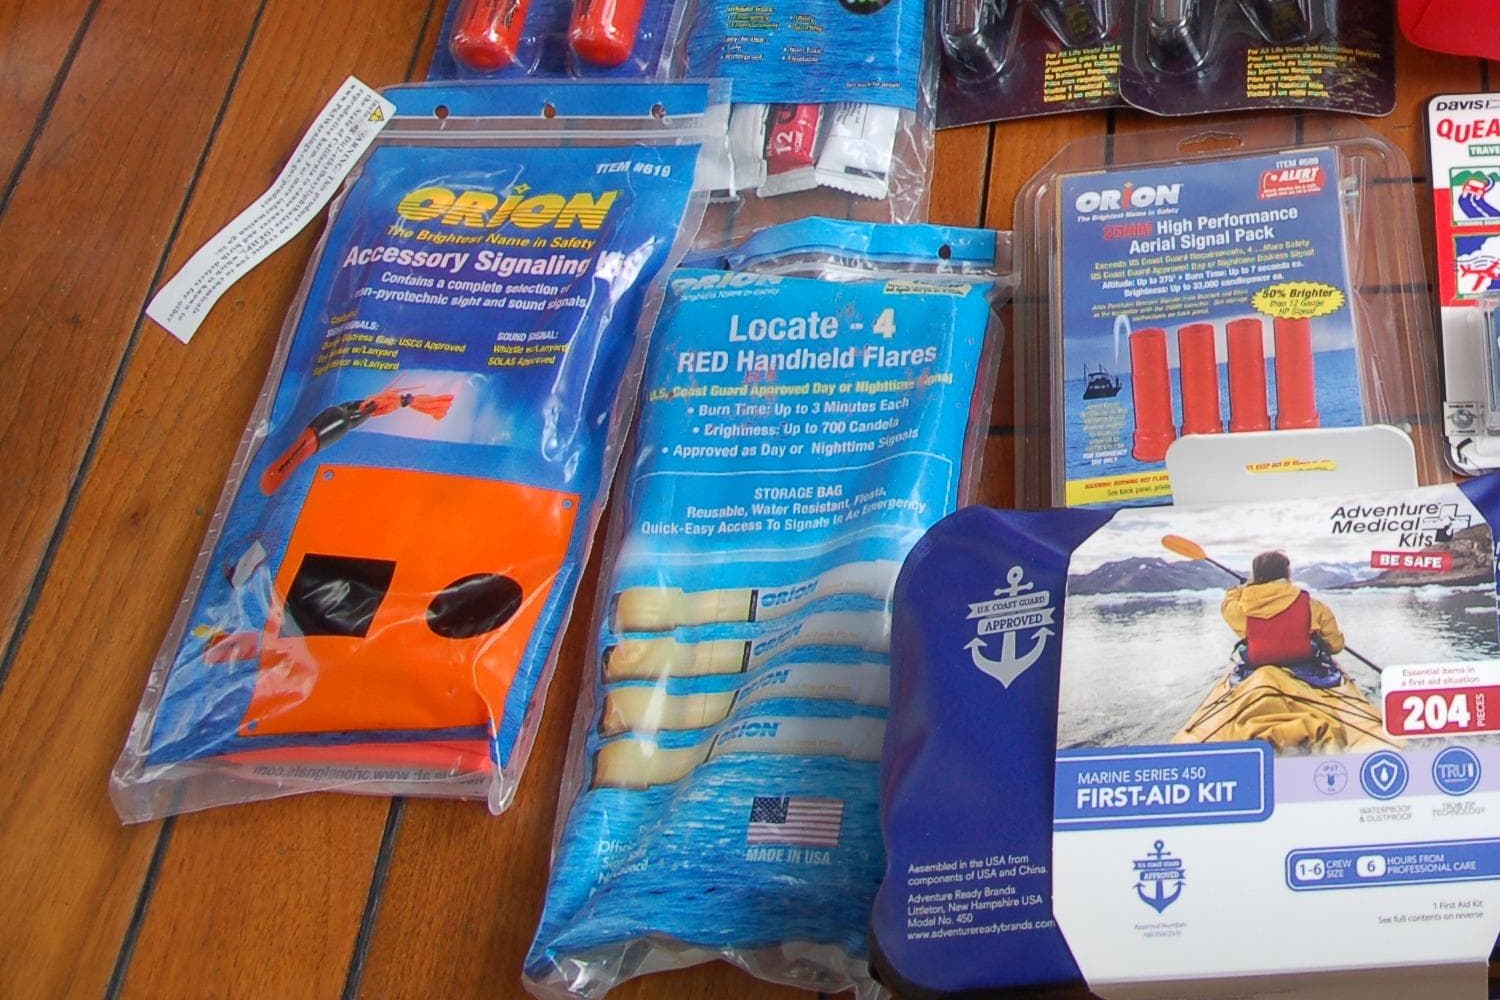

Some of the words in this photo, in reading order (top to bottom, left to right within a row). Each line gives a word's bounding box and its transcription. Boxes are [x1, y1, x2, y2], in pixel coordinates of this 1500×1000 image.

[776, 130, 793, 154] 12
[596, 161, 631, 175] ITEM
[396, 183, 619, 230] ORION
[1075, 181, 1182, 213] ORION
[1157, 219, 1192, 236] High
[1197, 207, 1299, 231] Performance
[417, 228, 484, 246] Brightest
[486, 232, 530, 248] Name
[534, 235, 547, 248] in
[550, 236, 597, 251] Safety
[1129, 236, 1176, 255] Aerial
[1180, 232, 1231, 252] Signal
[1235, 226, 1275, 242] Pack
[343, 246, 470, 273] Accessory
[475, 249, 592, 278] Signaling
[1262, 288, 1286, 299] 50%
[1289, 288, 1333, 299] Brighter
[729, 310, 839, 342] Locate
[872, 308, 896, 339] 4
[678, 351, 728, 374] RED
[736, 347, 855, 372] Handheld
[862, 345, 938, 368] Flares
[699, 403, 730, 417] Burn
[735, 402, 771, 417] Time:
[774, 402, 792, 418] Up
[794, 402, 808, 415] to
[811, 402, 821, 414] 3
[823, 400, 877, 414] Minutes
[880, 396, 909, 411] Each
[704, 422, 780, 439] Brightness:
[783, 421, 800, 437] Up
[804, 422, 818, 435] to
[822, 421, 846, 434] 700
[850, 417, 899, 433] Candela
[674, 441, 738, 459] Approved
[742, 444, 757, 457] as
[761, 441, 786, 459] Day
[790, 444, 804, 456] or
[811, 438, 875, 456] Nighttime
[878, 428, 919, 450] Signals
[754, 486, 814, 501] STORAGE
[817, 485, 843, 499] BAG
[1331, 503, 1439, 520] Adventure
[1332, 518, 1420, 534] Medical
[1399, 533, 1433, 547] Kits
[1379, 555, 1400, 566] BE
[1403, 556, 1442, 569] SAFE
[984, 611, 1044, 632] APPROVED
[1402, 693, 1470, 732] 204
[1476, 693, 1486, 727] PIECES
[1078, 770, 1132, 784] MARINE
[1134, 768, 1180, 782] SERIES
[1182, 766, 1207, 780] 450
[1077, 784, 1190, 809] FIRST-AID
[1198, 781, 1237, 803] KIT
[746, 848, 784, 863] MADE
[787, 849, 801, 864] IN
[804, 851, 832, 865] USA
[908, 861, 957, 874] Assembled
[960, 860, 967, 869] in
[970, 858, 983, 868] the
[986, 856, 1006, 867] USA
[1008, 855, 1029, 864] from
[1387, 856, 1417, 866] HOURS
[1419, 854, 1445, 863] FROM
[908, 873, 963, 886] components
[966, 871, 975, 880] of
[977, 869, 996, 880] USA
[1000, 867, 1016, 877] and
[1019, 864, 1047, 875] China.
[1299, 863, 1322, 876] 1-6
[1326, 860, 1352, 869] CREW
[1326, 869, 1344, 878] SIZE
[1367, 860, 1376, 873] 6
[1387, 863, 1452, 875] PROFESSIONAL
[1454, 861, 1476, 871] CARE
[908, 893, 952, 904] Adventure
[955, 889, 982, 900] Ready
[984, 886, 1015, 897] Brands
[949, 902, 968, 912] New
[971, 898, 1019, 911] Hampshire
[1022, 895, 1043, 905] USA
[907, 920, 1056, 940] www.adventurereadybrands.com
